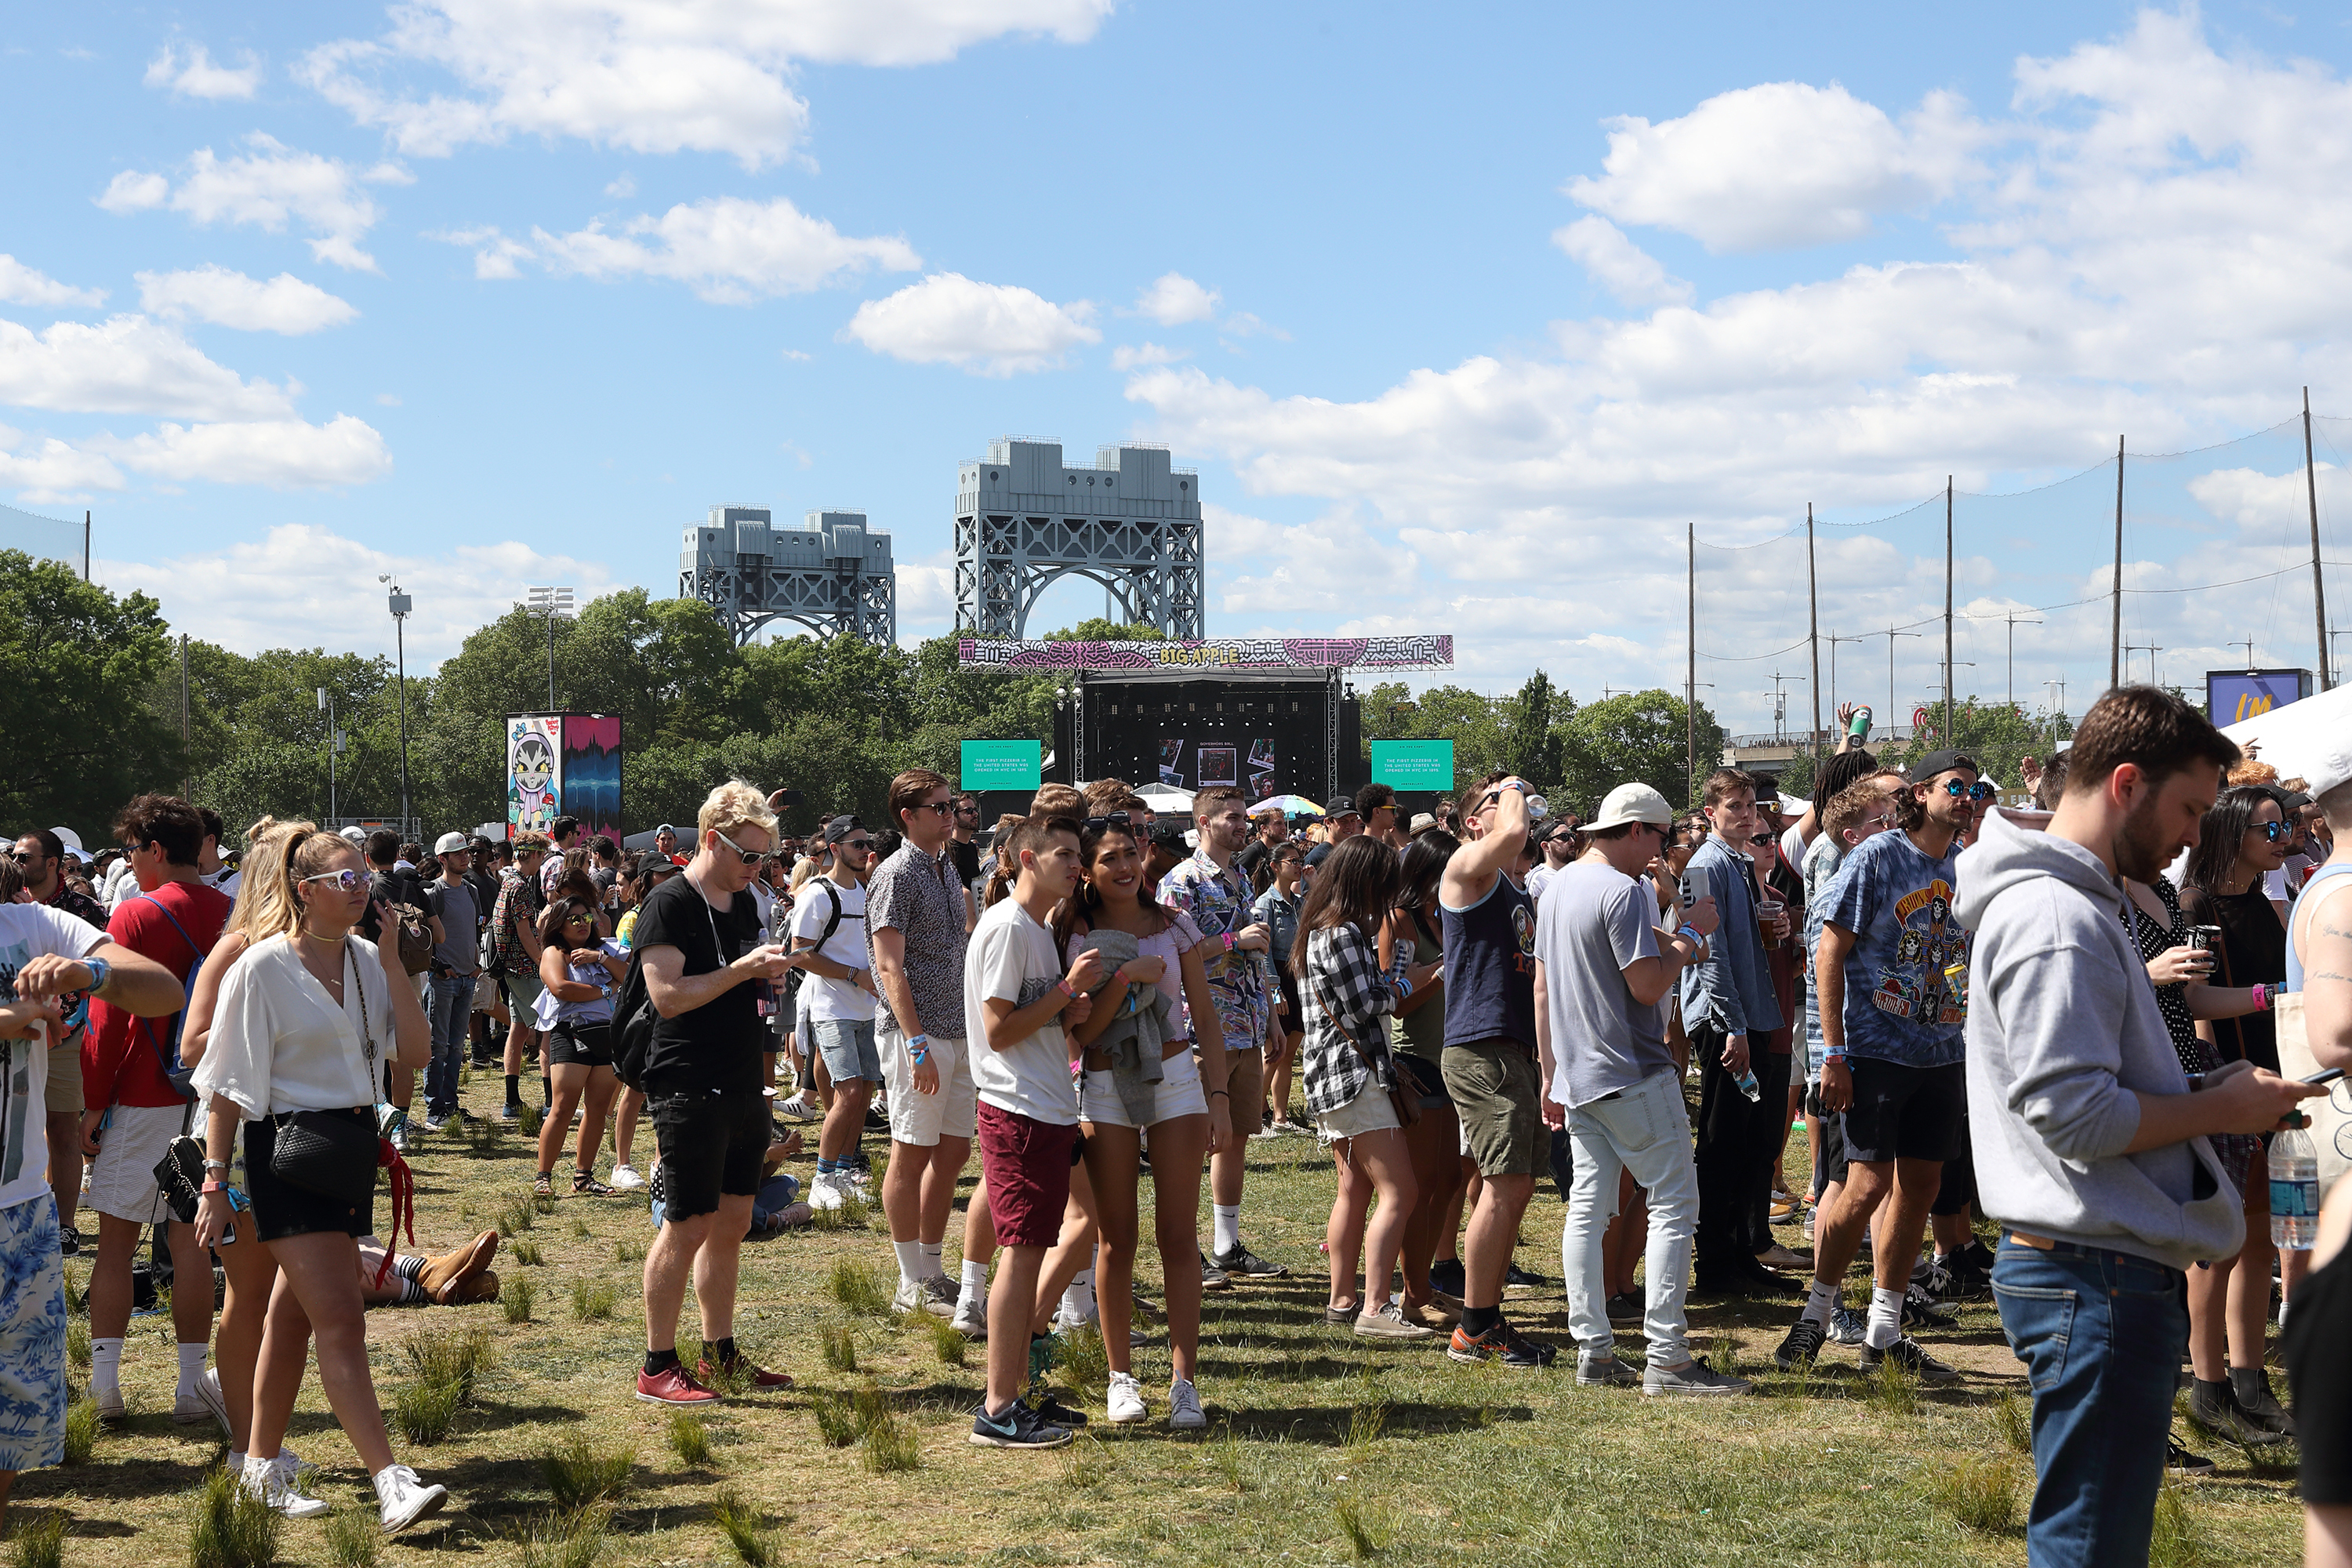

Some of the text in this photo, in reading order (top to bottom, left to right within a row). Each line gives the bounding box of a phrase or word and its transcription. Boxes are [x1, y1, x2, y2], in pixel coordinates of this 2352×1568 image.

[1161, 648, 1239, 664] BIG APPLE
[2235, 693, 2272, 722] I'M
[2010, 795, 2032, 804] ENT
[1946, 927, 1964, 936] TOUR
